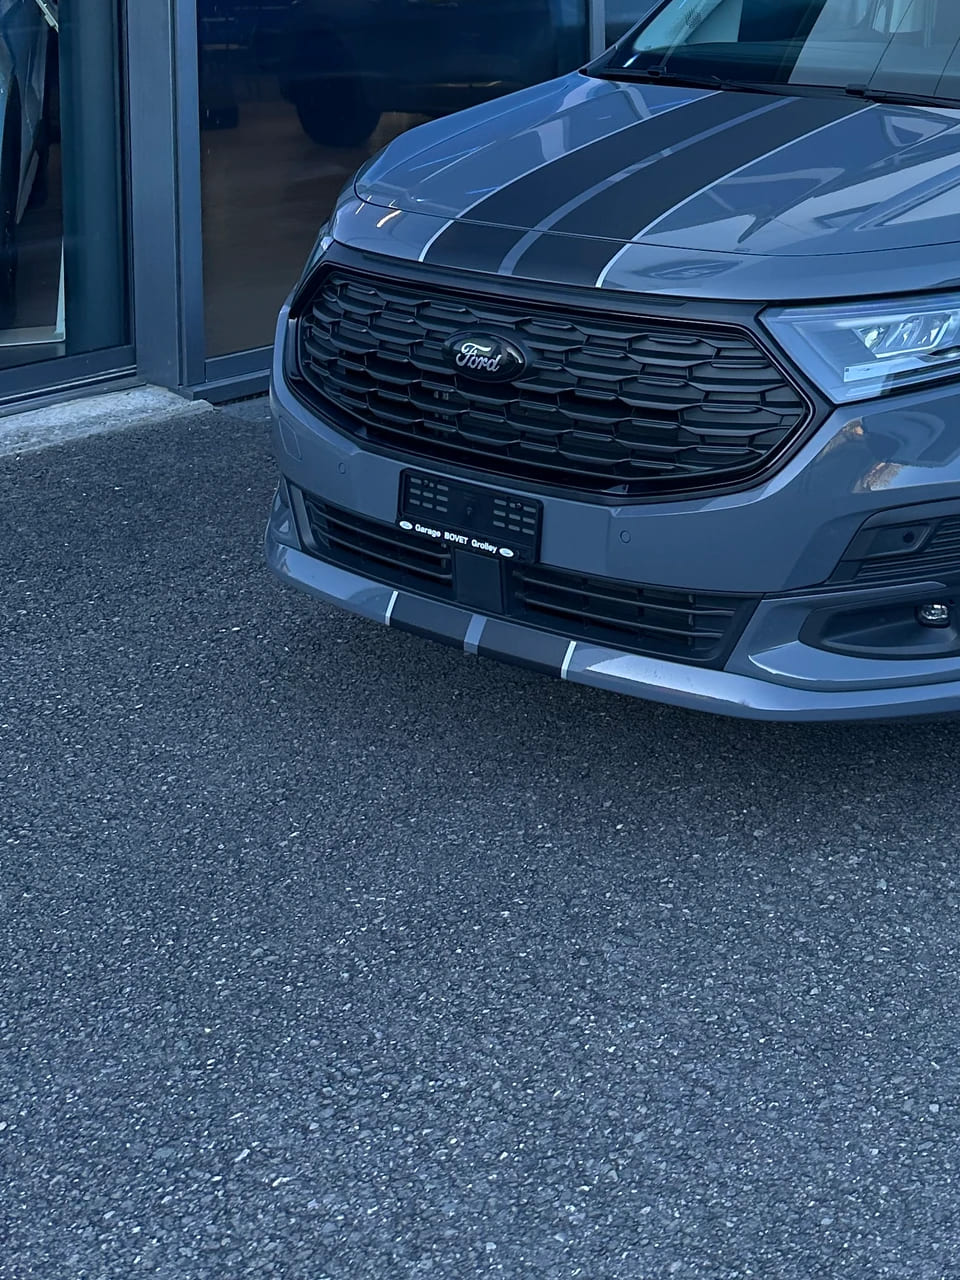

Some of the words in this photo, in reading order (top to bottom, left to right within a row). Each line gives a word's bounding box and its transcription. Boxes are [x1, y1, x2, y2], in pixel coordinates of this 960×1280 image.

[456, 342, 502, 372] Ford
[415, 523, 441, 538] Garage
[444, 531, 468, 545] BOVET
[471, 538, 498, 553] Grolley
